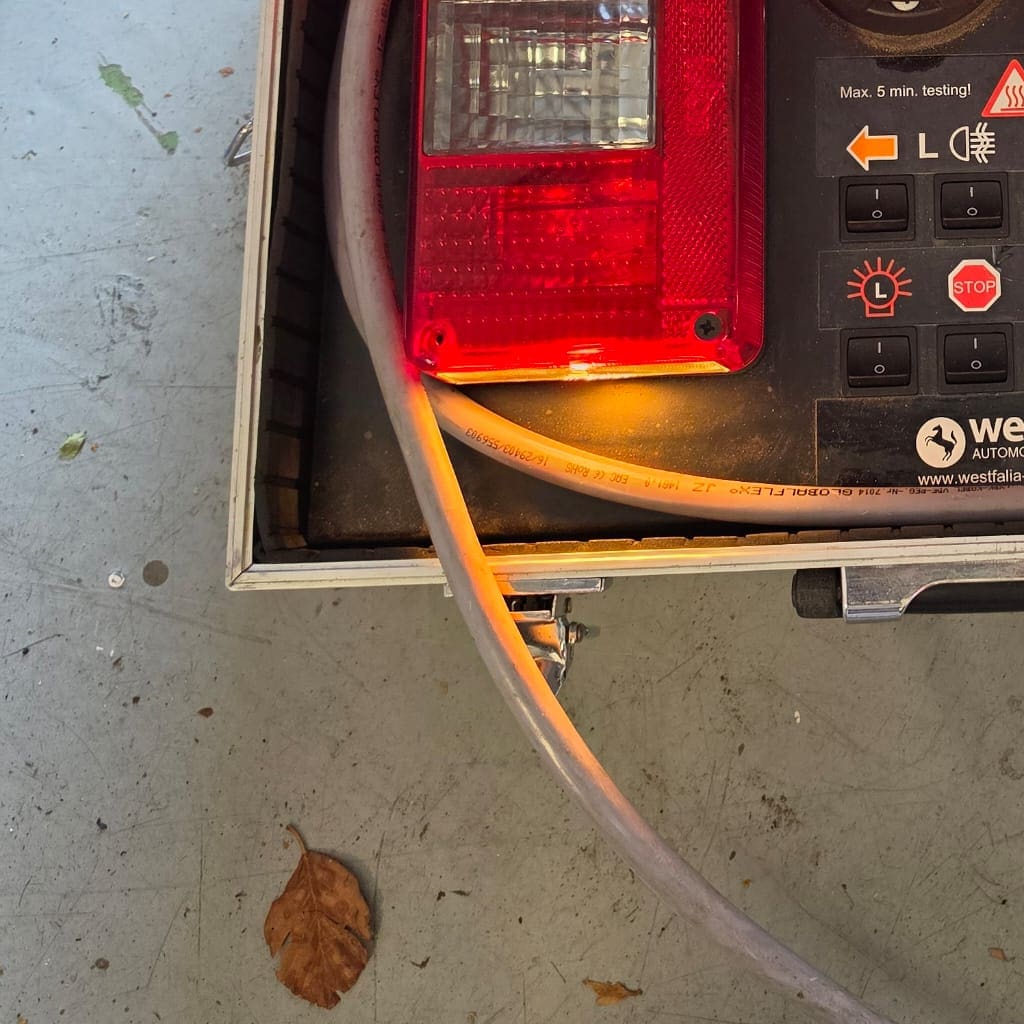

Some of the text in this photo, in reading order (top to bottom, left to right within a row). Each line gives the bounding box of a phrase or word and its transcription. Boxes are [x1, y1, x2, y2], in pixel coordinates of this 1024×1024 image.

[840, 83, 971, 98] Max. 5 min. testing!
[918, 132, 939, 158] L
[875, 282, 887, 298] L
[953, 280, 996, 294] STOP
[692, 482, 717, 494] JZ
